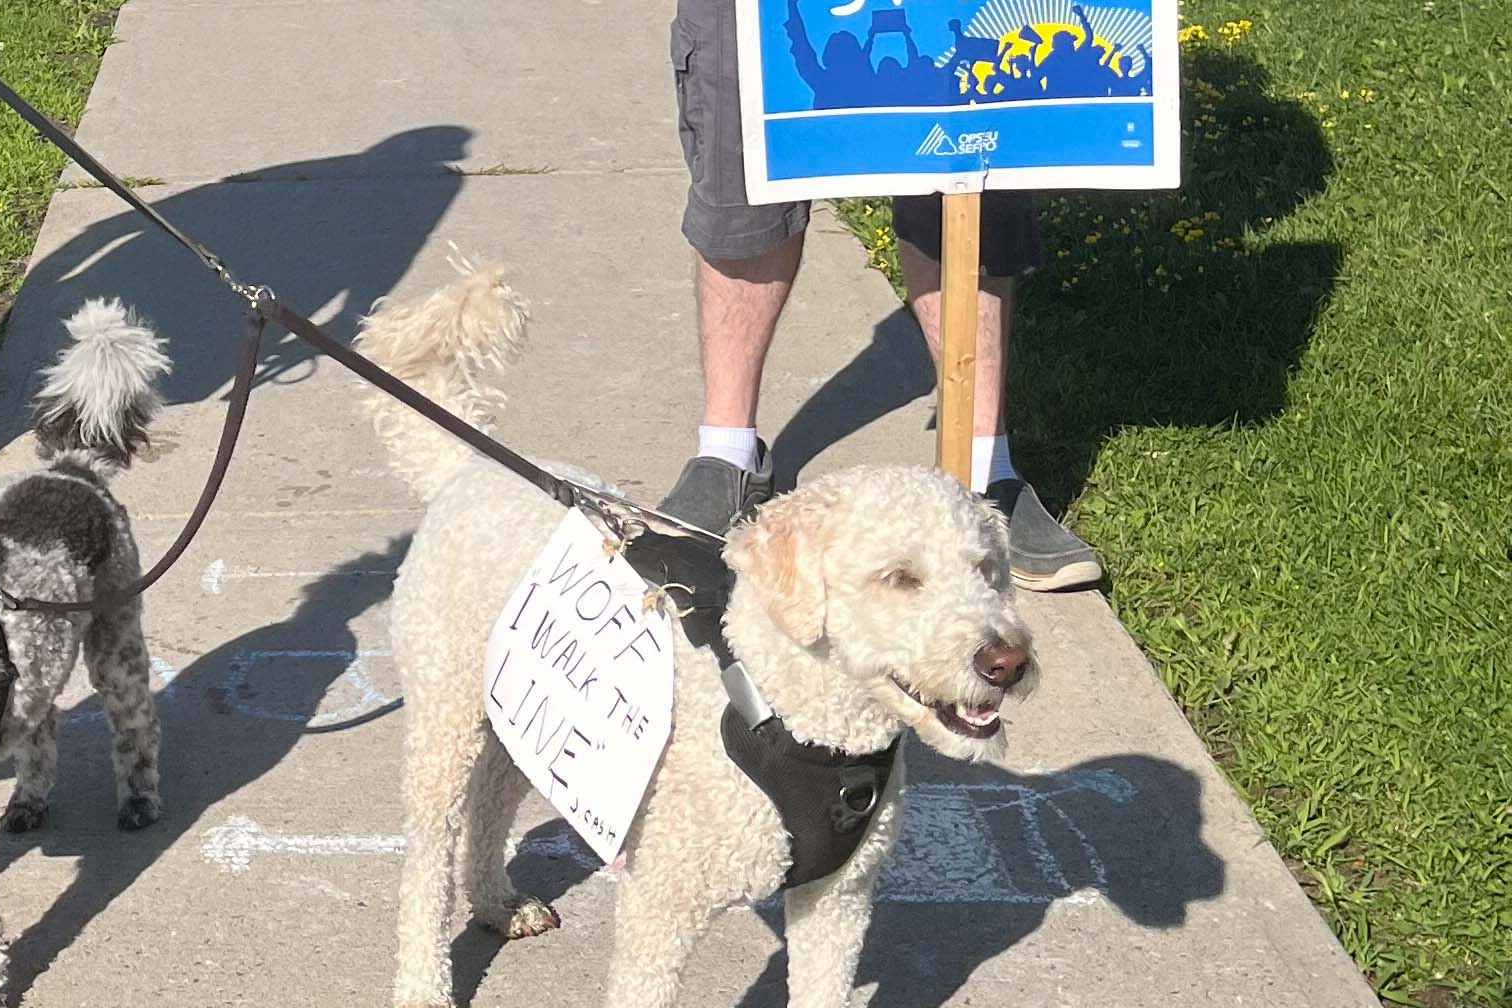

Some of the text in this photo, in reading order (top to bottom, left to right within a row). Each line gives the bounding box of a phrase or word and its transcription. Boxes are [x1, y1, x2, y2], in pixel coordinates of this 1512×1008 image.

[549, 543, 661, 662] WOFF
[531, 610, 598, 701] WALK
[608, 686, 649, 740] THE
